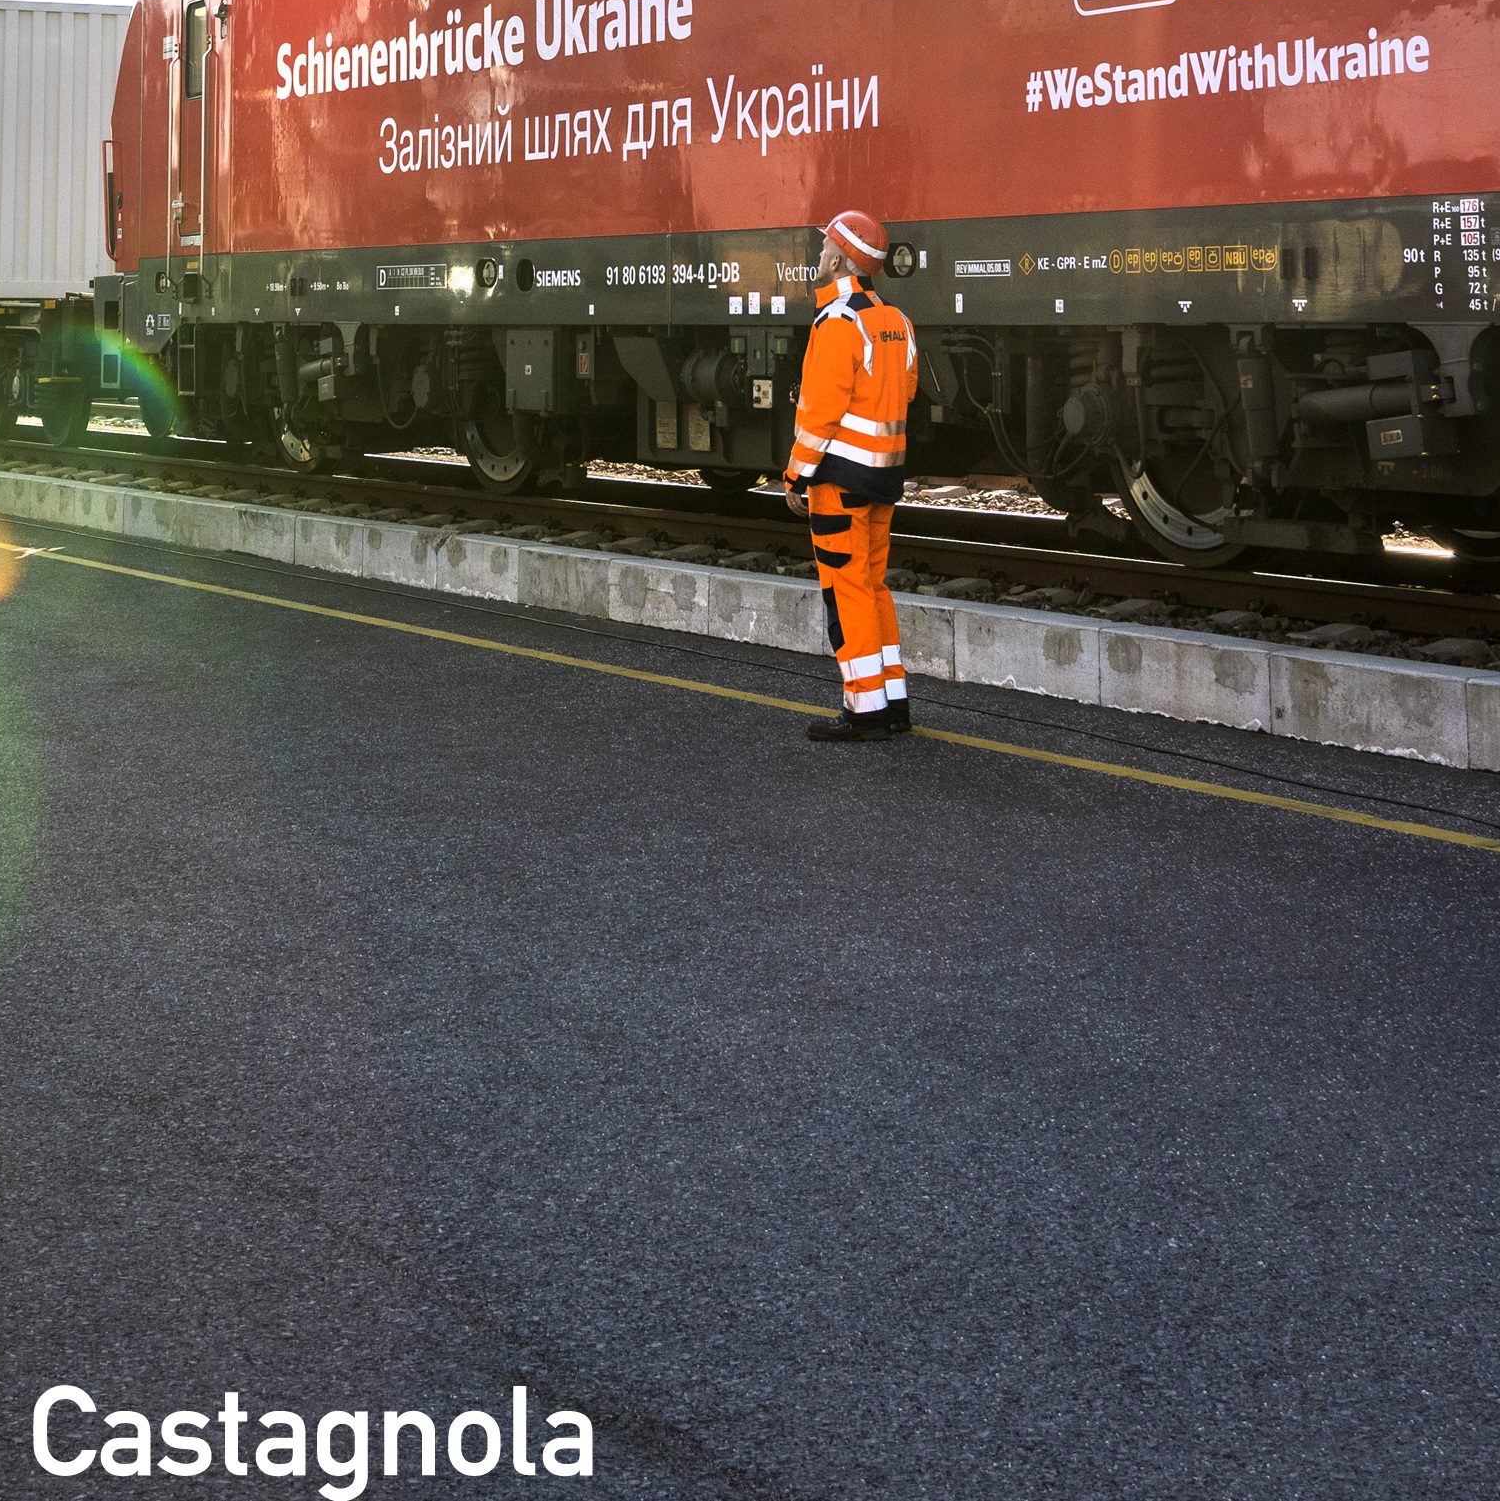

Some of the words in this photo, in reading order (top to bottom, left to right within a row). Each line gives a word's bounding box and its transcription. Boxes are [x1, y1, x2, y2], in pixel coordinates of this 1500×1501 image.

[276, 3, 525, 101] Schienenbrücke
[1025, 27, 1431, 113] #WeStandWithUkraine
[377, 104, 513, 175] Залізний
[524, 105, 613, 162] шлях
[622, 96, 693, 161] для
[706, 63, 880, 158] України
[1461, 200, 1478, 212] 176
[1480, 201, 1485, 211] t
[1433, 217, 1452, 230] R+E
[1462, 216, 1478, 228] 157
[1480, 217, 1485, 228] t
[1433, 234, 1452, 246] P+E
[1462, 233, 1479, 245] 105
[1481, 234, 1486, 244] t
[1403, 248, 1419, 263] 90
[1434, 250, 1442, 262] R
[1462, 249, 1480, 261] 135
[1481, 250, 1487, 261] t
[956, 263, 968, 274] REV
[1037, 257, 1050, 270] KE
[1057, 257, 1076, 270] GPR
[1083, 257, 1090, 269] E
[1092, 256, 1107, 269] mZ
[380, 269, 386, 286] D
[535, 269, 581, 287] SIEMENS
[606, 266, 619, 285] 91
[622, 265, 636, 285] 80
[638, 264, 666, 285] 6193
[672, 263, 705, 284] 394-4
[708, 262, 740, 285] D-DB
[775, 262, 820, 282] Vectro
[1434, 267, 1441, 278] P
[1467, 265, 1480, 278] 95
[1482, 267, 1488, 277] t
[1435, 283, 1443, 295] G
[1468, 282, 1481, 294] 72
[1482, 283, 1488, 294] t
[1469, 299, 1481, 310] 45
[1483, 300, 1488, 310] t
